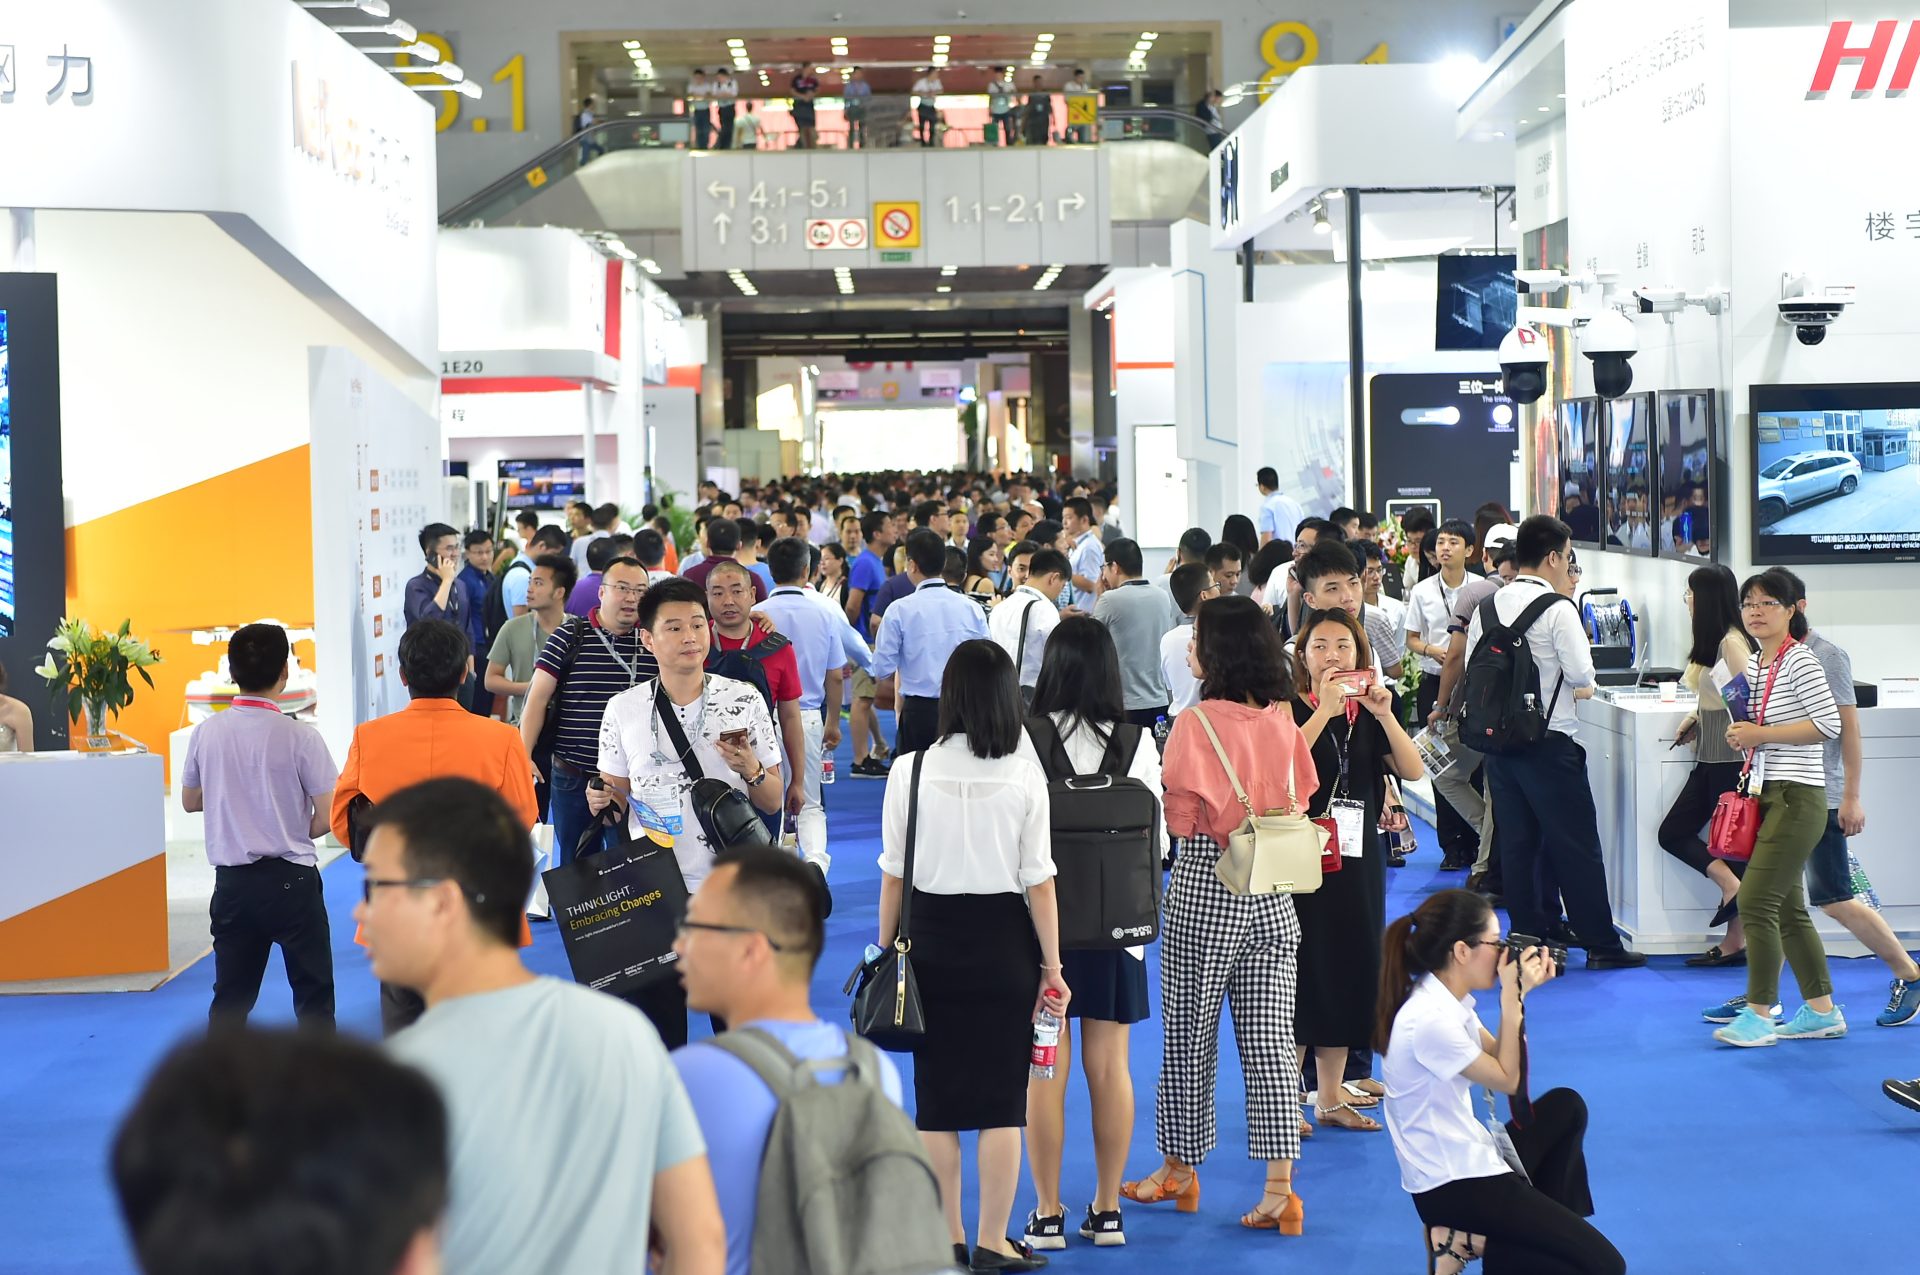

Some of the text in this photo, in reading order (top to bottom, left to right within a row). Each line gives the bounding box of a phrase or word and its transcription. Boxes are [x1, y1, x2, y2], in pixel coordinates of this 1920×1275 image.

[394, 32, 524, 133] 8.1
[748, 180, 848, 209] 4.1-5.1
[946, 193, 1044, 223] 1.1-2.1
[751, 215, 788, 245] 3.1
[1844, 542, 1872, 551] accurately
[1872, 541, 1891, 549] record
[1891, 541, 1901, 549] the
[566, 885, 636, 918] THINKLIGHT:
[569, 889, 662, 930] Embracing Changes
[1043, 1225, 1059, 1234] NIKE
[1103, 1220, 1119, 1230] NIKE
